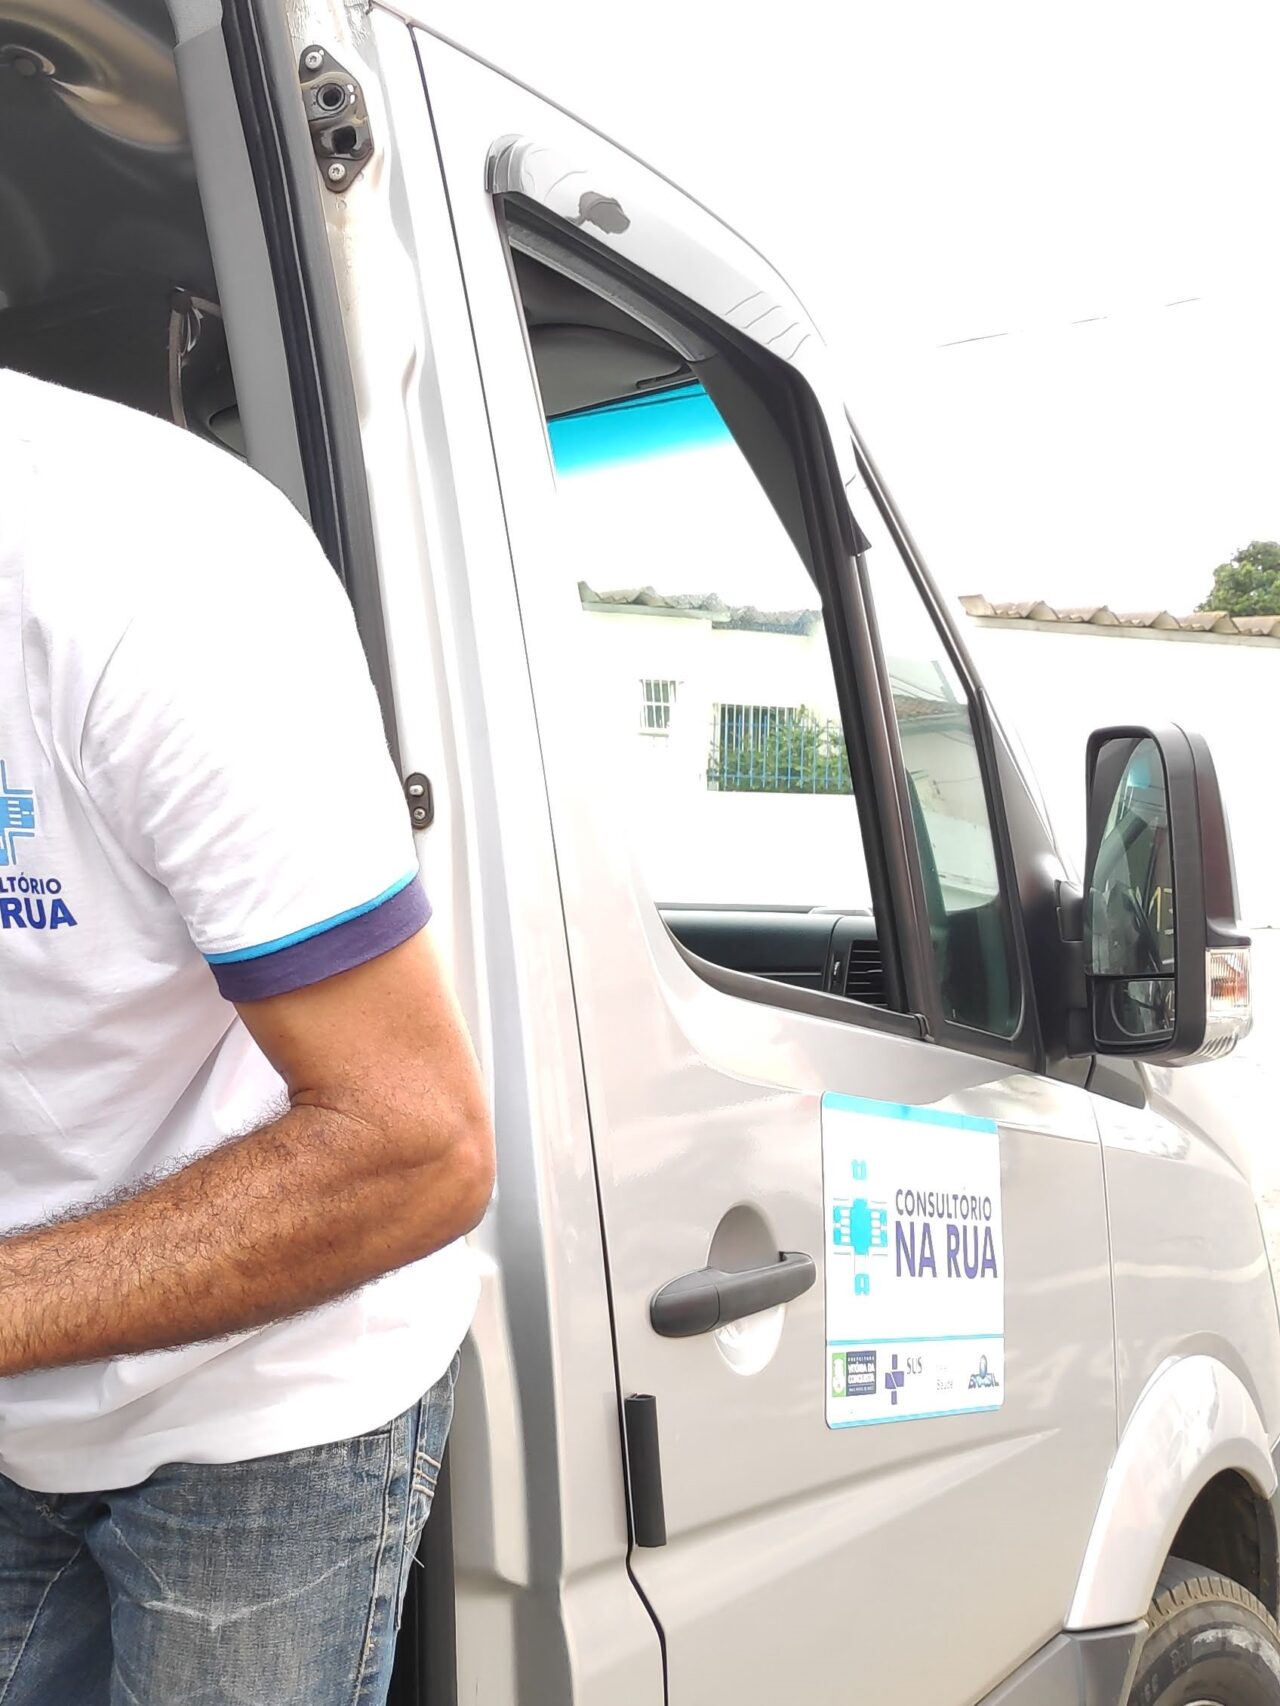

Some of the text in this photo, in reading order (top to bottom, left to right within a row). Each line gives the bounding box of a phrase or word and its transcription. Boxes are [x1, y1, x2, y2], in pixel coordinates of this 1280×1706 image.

[895, 1186, 992, 1221] CONSULTÓRIO
[895, 1220, 998, 1279] NA RUA
[906, 1356, 923, 1375] SUS
